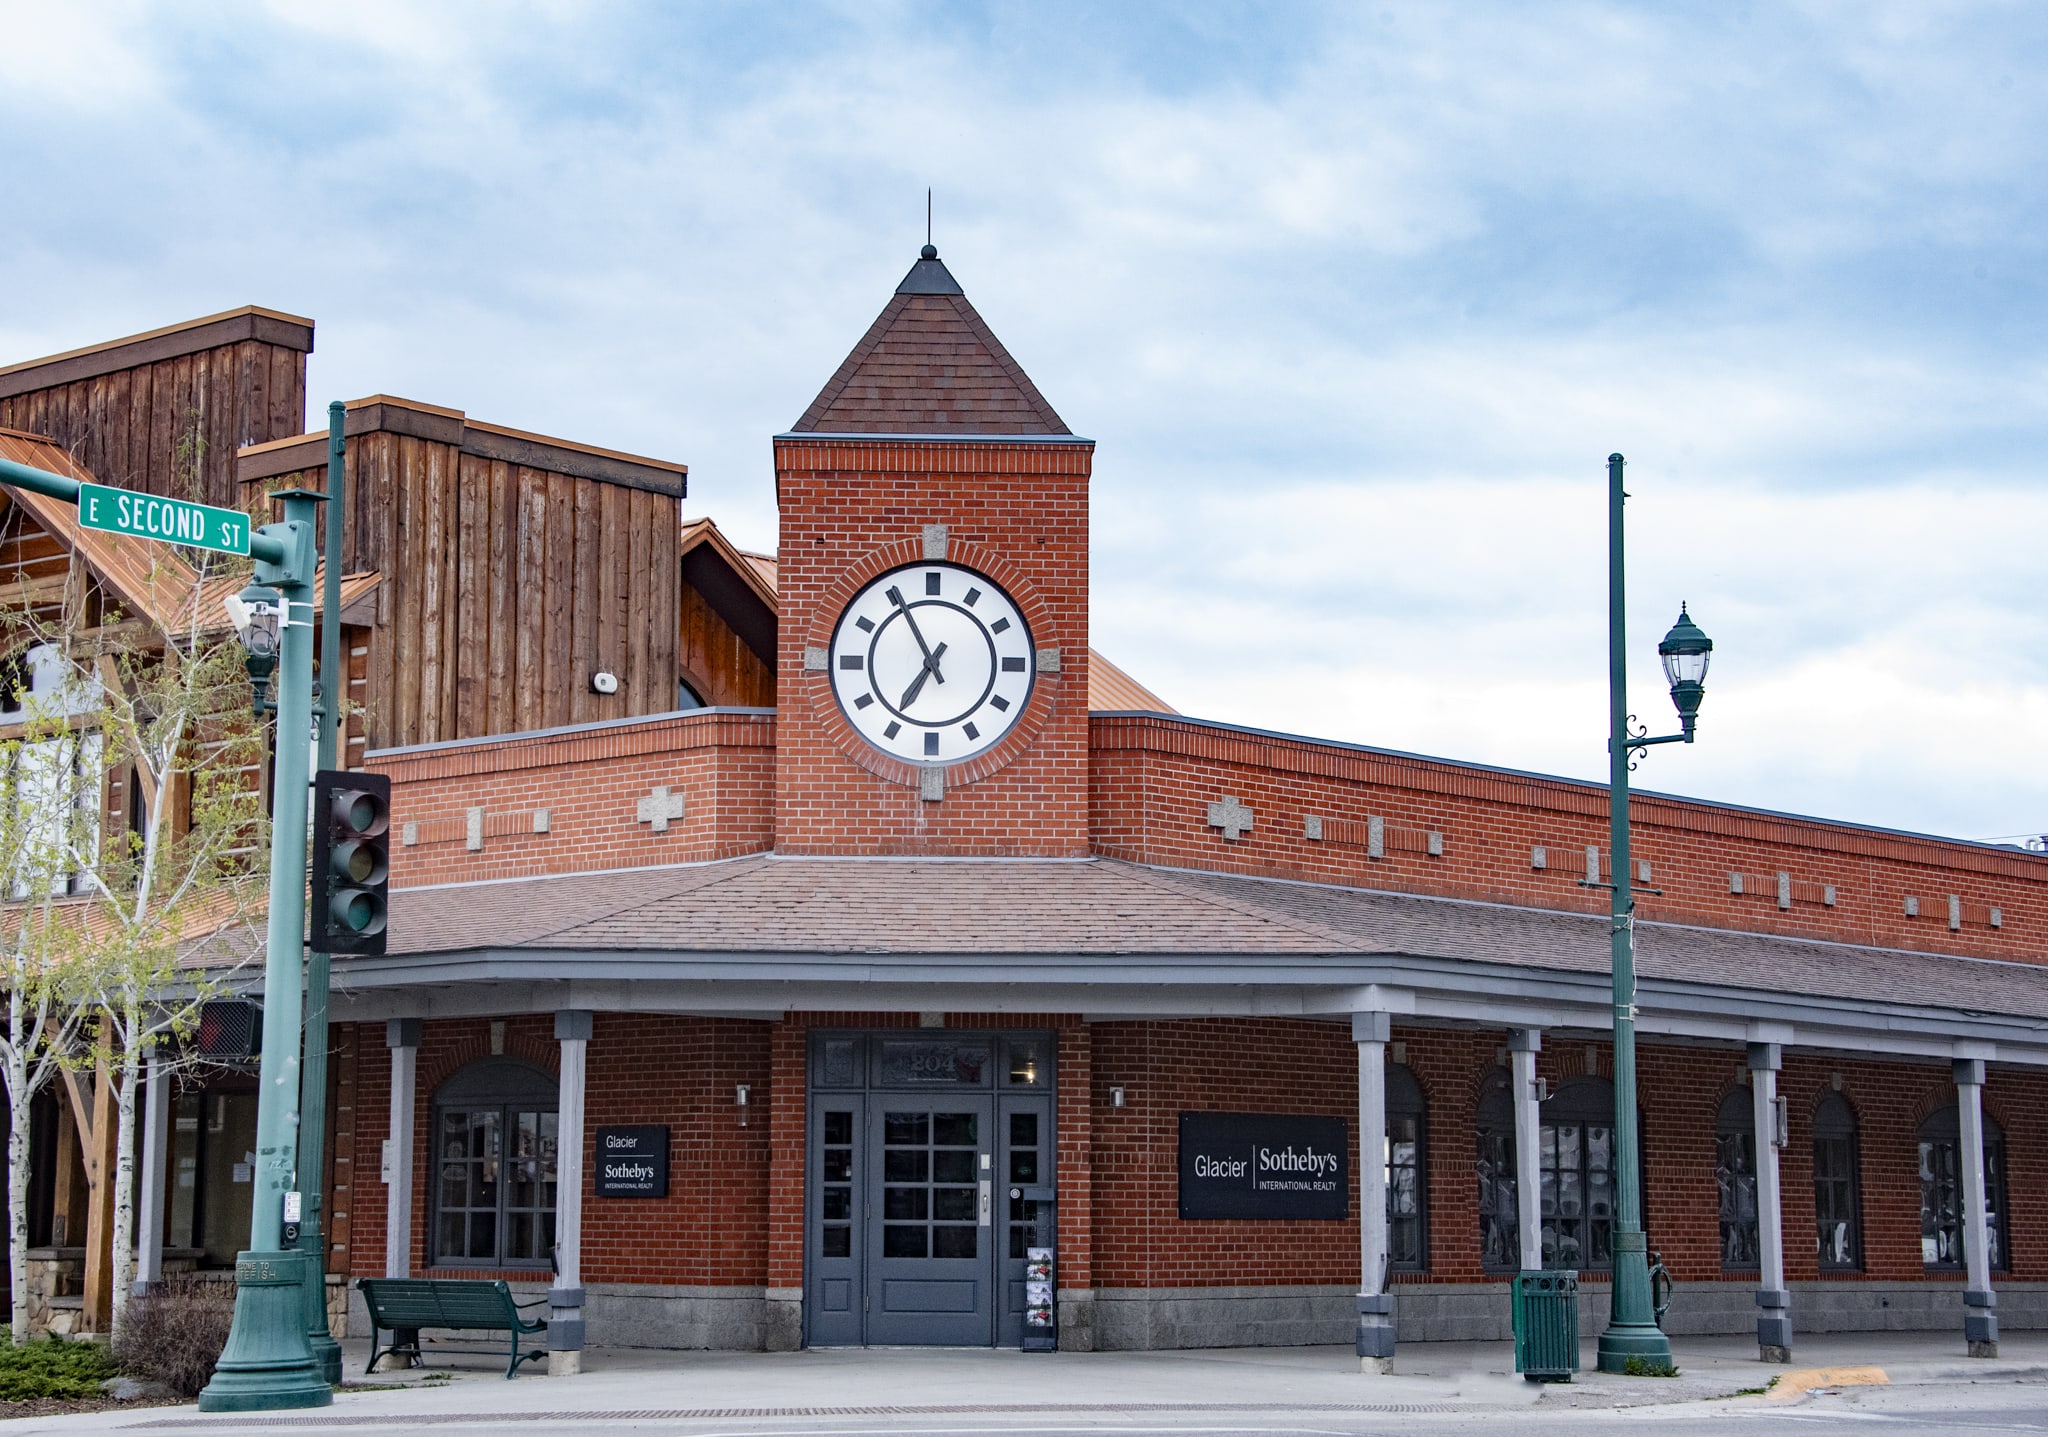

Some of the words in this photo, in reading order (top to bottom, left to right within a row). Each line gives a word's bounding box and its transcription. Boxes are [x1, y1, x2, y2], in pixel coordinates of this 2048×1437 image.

[89, 498, 99, 523] E
[117, 495, 205, 542] SECOND
[221, 522, 241, 548] ST
[910, 1054, 957, 1072] 204
[606, 1135, 638, 1148] Glacier
[1194, 1154, 1247, 1178] Glacier
[1259, 1145, 1338, 1177] Sotheby's
[605, 1163, 654, 1181] Sotheby's
[1259, 1181, 1312, 1191] INTERNATIONAL
[1313, 1182, 1337, 1191] REALTY
[260, 1262, 270, 1270] TO
